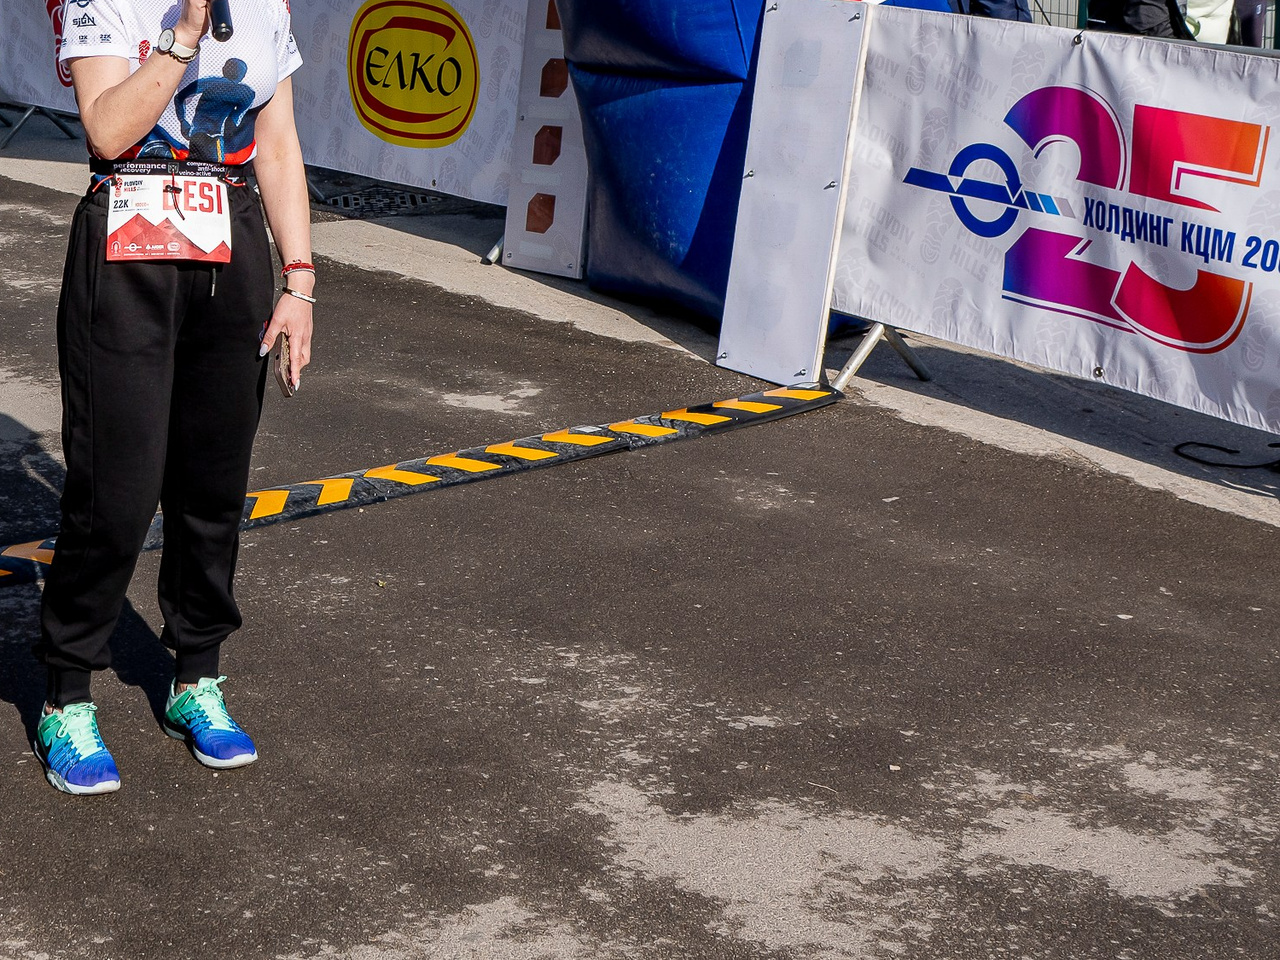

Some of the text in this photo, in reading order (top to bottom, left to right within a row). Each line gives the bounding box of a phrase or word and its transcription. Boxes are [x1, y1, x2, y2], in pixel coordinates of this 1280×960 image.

[934, 73, 970, 110] HILLS
[940, 52, 999, 101] PLOVDIV
[113, 161, 167, 171] performance
[120, 167, 151, 175] recovery
[113, 199, 129, 209] 22K
[162, 179, 223, 214] DESI
[859, 195, 916, 246] PLOVDIV
[1002, 84, 1270, 354] 25
[1083, 196, 1280, 274] ХОЛДИНГ КЦМ 20
[949, 243, 988, 283] HILLS
